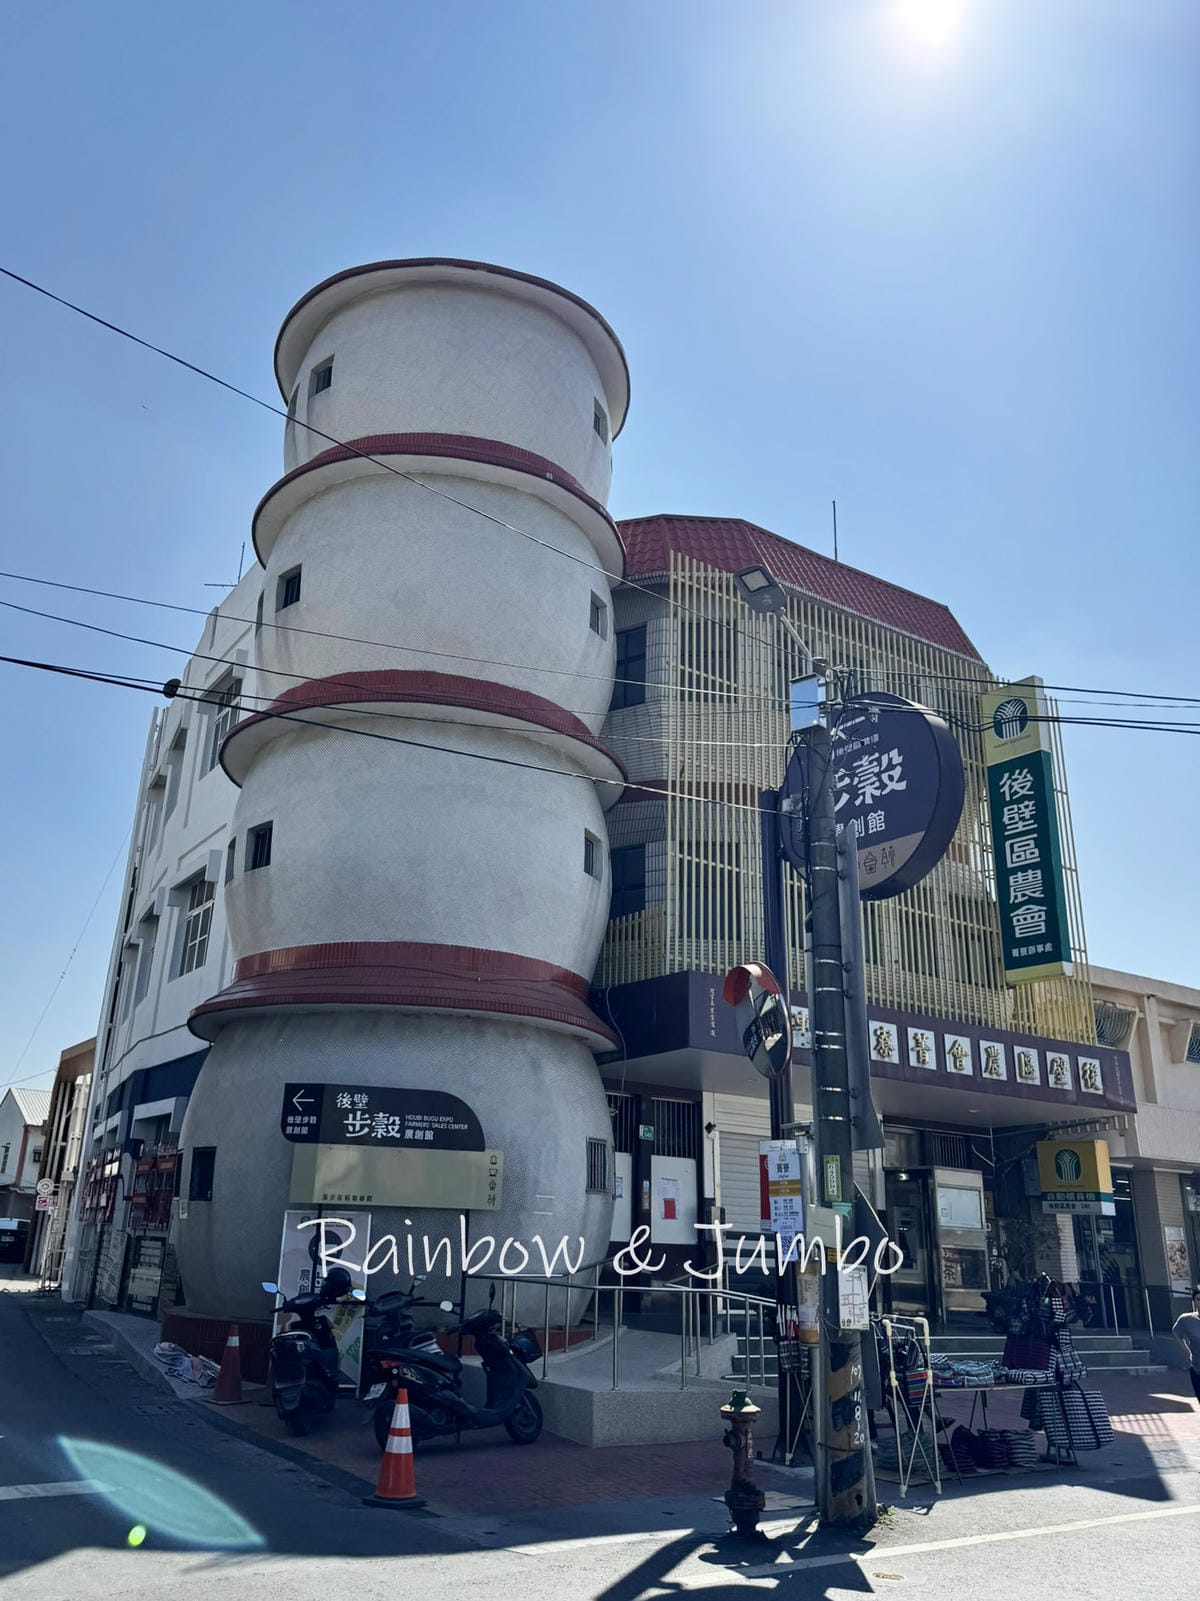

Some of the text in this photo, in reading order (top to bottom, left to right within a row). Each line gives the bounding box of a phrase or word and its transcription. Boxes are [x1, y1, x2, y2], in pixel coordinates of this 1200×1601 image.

[999, 768, 1048, 938] 後壁區農會
[336, 1092, 369, 1109] 後壁
[343, 1110, 401, 1139] 步穀
